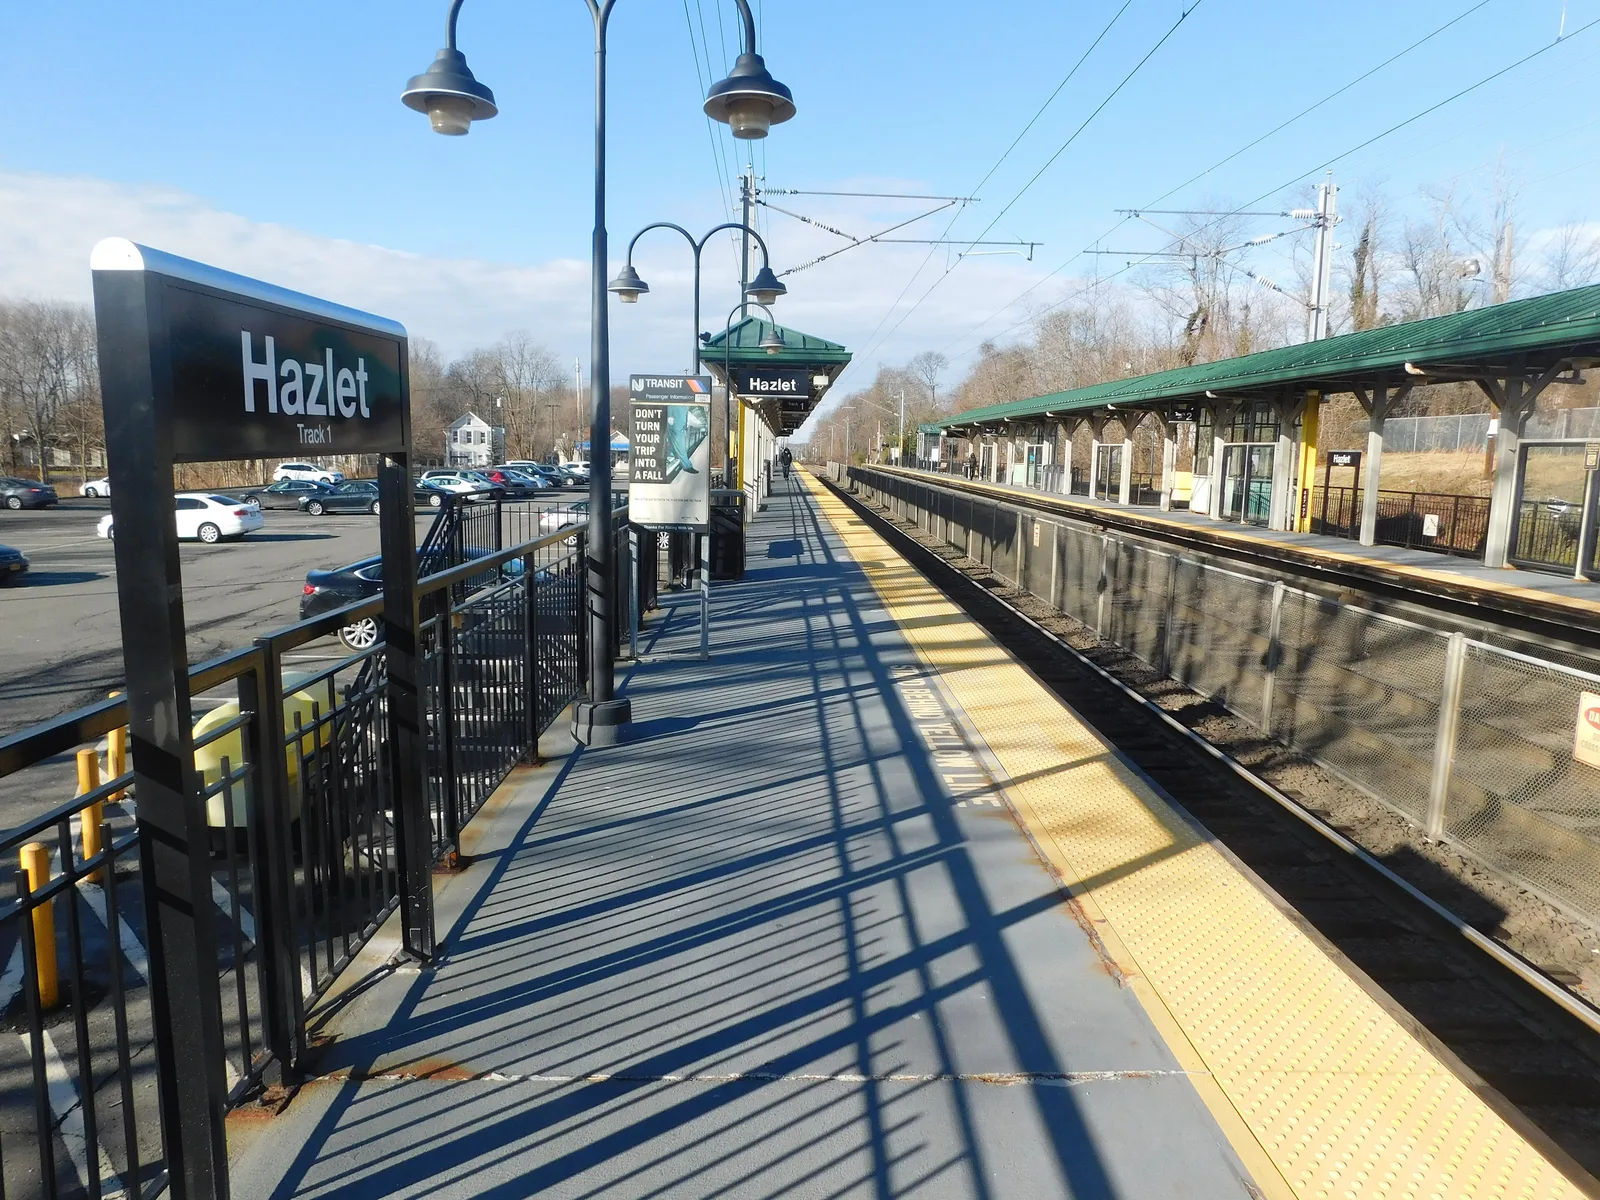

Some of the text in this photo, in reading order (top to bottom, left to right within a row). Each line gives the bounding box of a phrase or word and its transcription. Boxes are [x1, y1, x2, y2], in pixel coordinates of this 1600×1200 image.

[241, 330, 370, 418] Hazlet
[645, 378, 684, 389] TRANSIT
[749, 377, 797, 392] Hazlet
[645, 393, 669, 401] Passenger
[799, 402, 804, 410] 1
[635, 408, 663, 419] DON'T
[1185, 412, 1193, 421] 2
[635, 421, 660, 431] TURN
[297, 423, 332, 444] Track 1
[635, 433, 660, 443] YOUR
[635, 445, 656, 456] TRIP
[635, 458, 657, 468] INTO
[1333, 454, 1351, 464] Hazlet
[634, 470, 663, 481] A FALL
[900, 688, 947, 719] BEHIND
[918, 722, 978, 768] YELLOW
